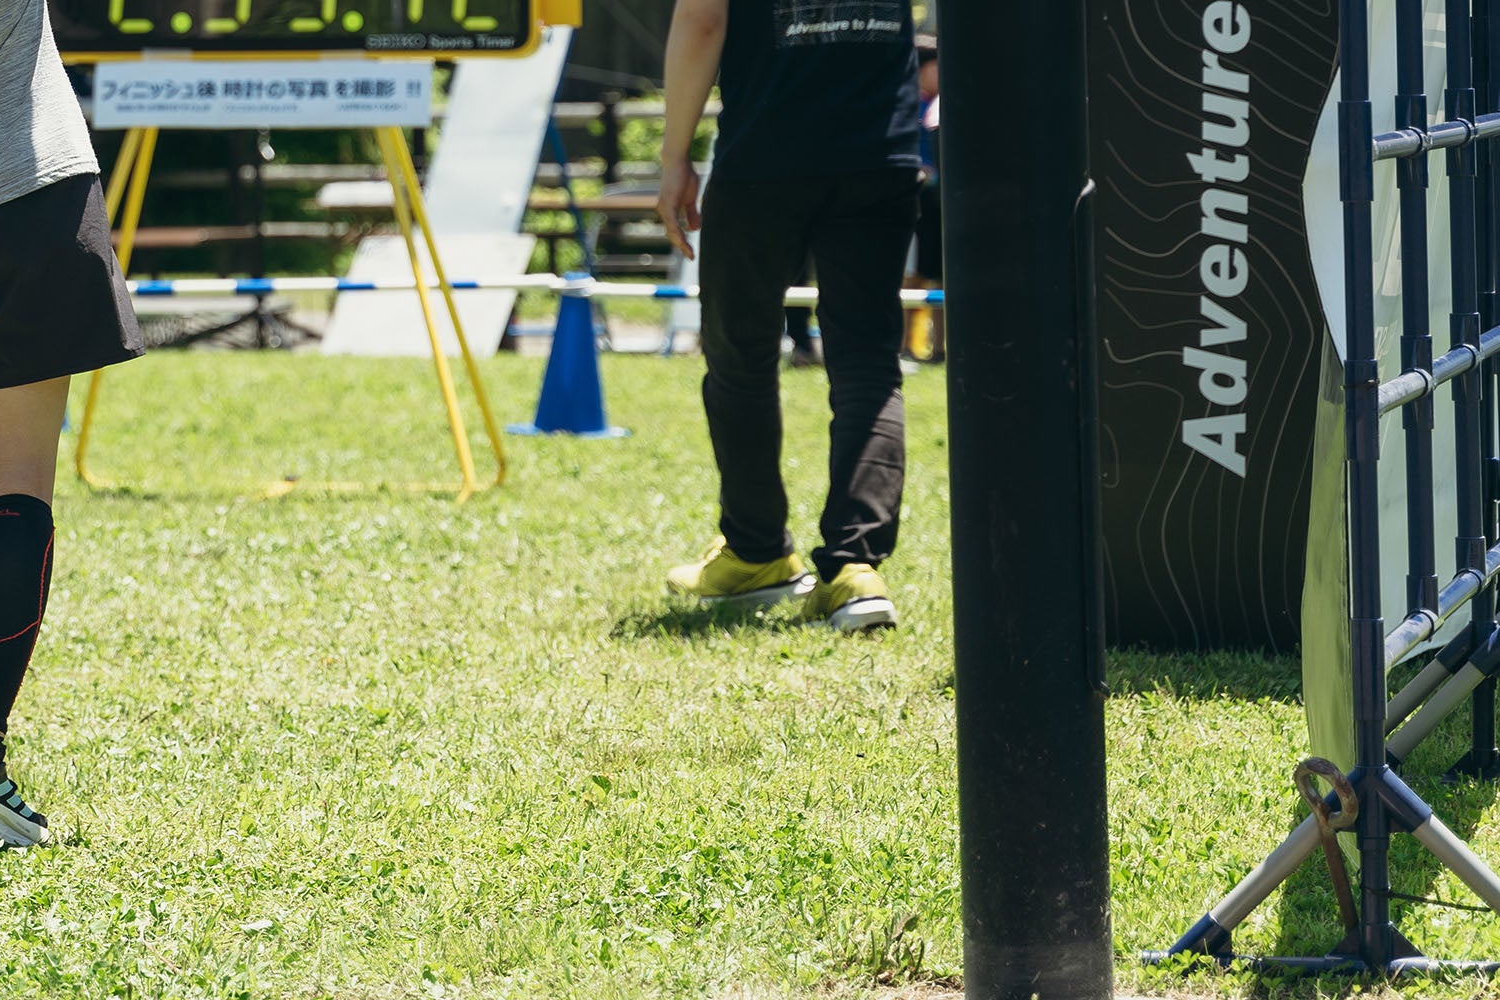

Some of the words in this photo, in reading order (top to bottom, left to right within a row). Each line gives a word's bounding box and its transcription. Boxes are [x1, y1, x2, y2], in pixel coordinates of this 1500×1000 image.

[785, 20, 850, 37] Adventure
[851, 18, 865, 30] to
[429, 34, 474, 50] Sports
[476, 34, 515, 48] Timer
[1182, 0, 1252, 477] Adventure
